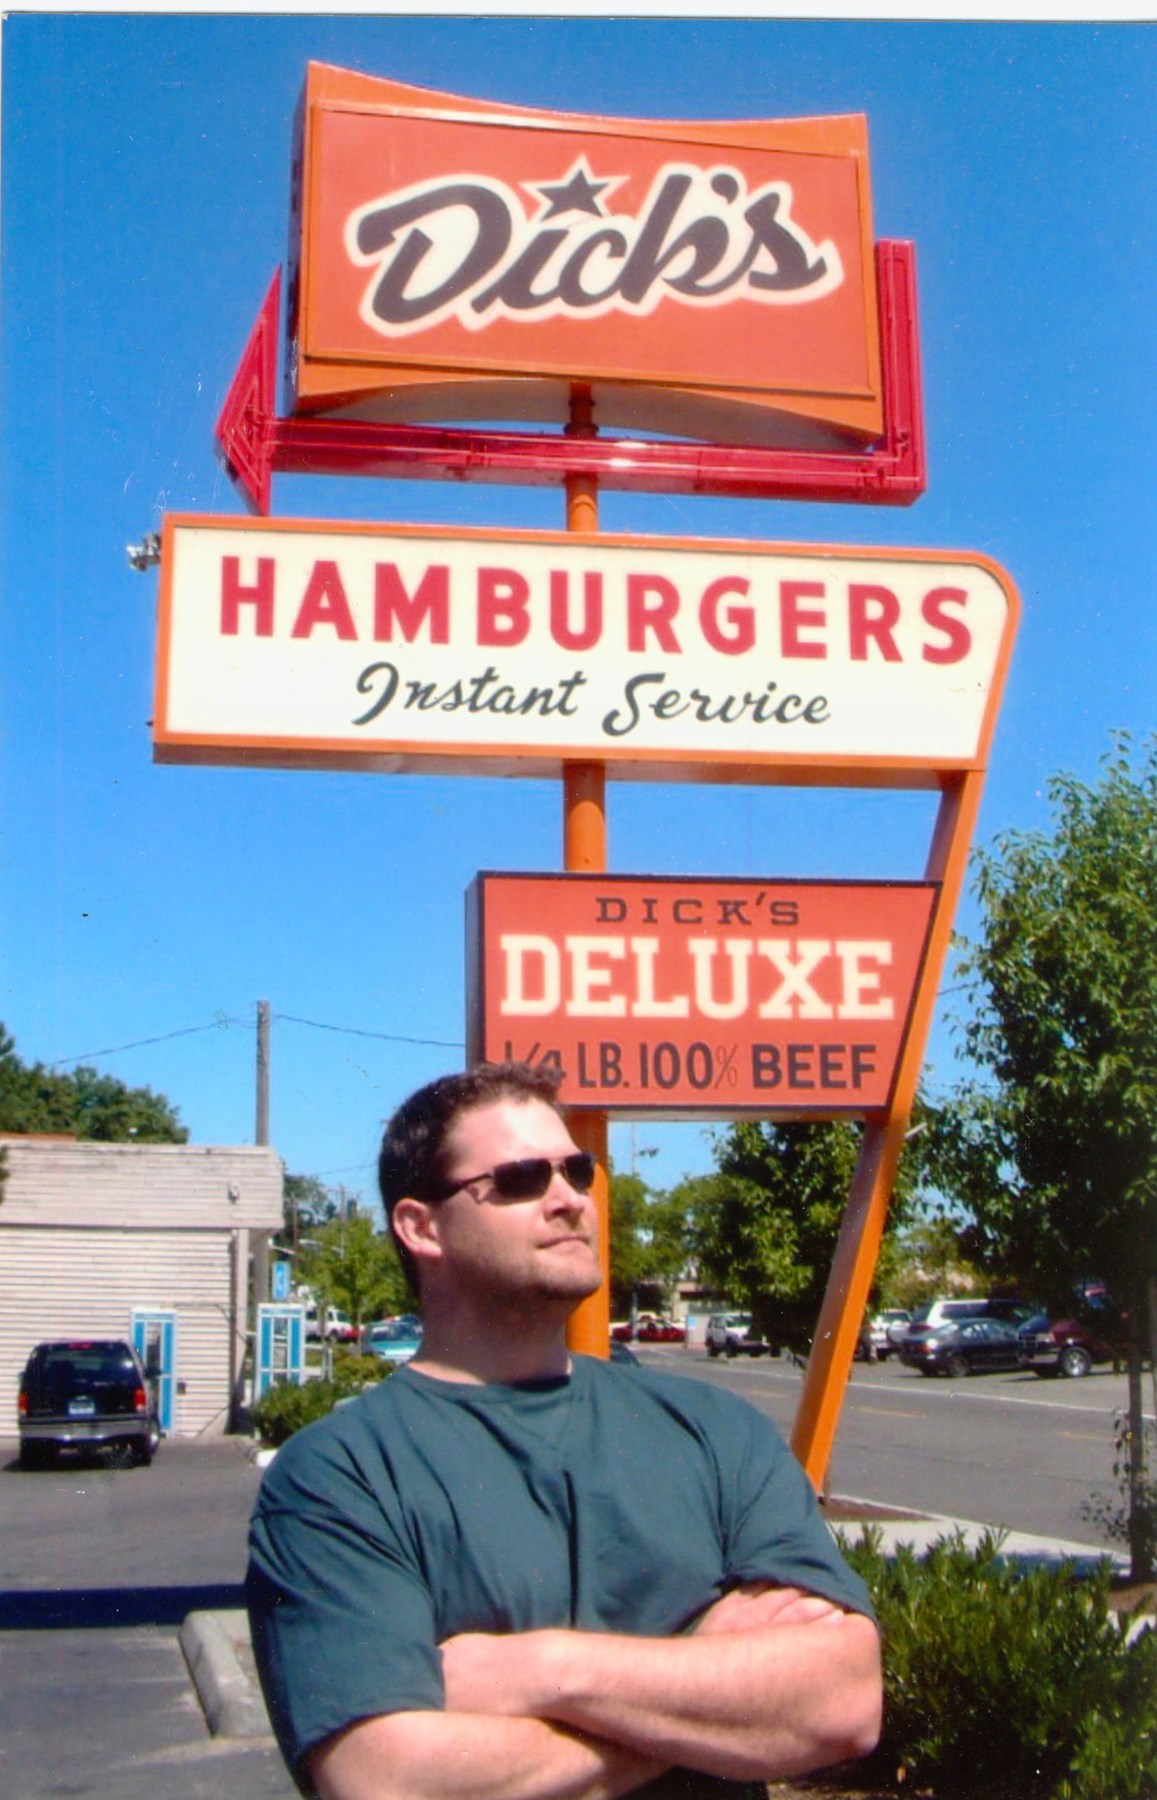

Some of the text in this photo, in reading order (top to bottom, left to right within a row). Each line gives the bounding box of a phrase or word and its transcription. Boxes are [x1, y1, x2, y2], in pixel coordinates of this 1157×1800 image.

[348, 160, 838, 332] Dick's
[219, 555, 972, 665] HAMBURGERS
[351, 661, 831, 738] Instant Service
[596, 890, 799, 926] DICK'S
[499, 934, 895, 1020] DELUXE
[640, 1043, 739, 1089] 100%
[751, 1044, 877, 1089] BEEF
